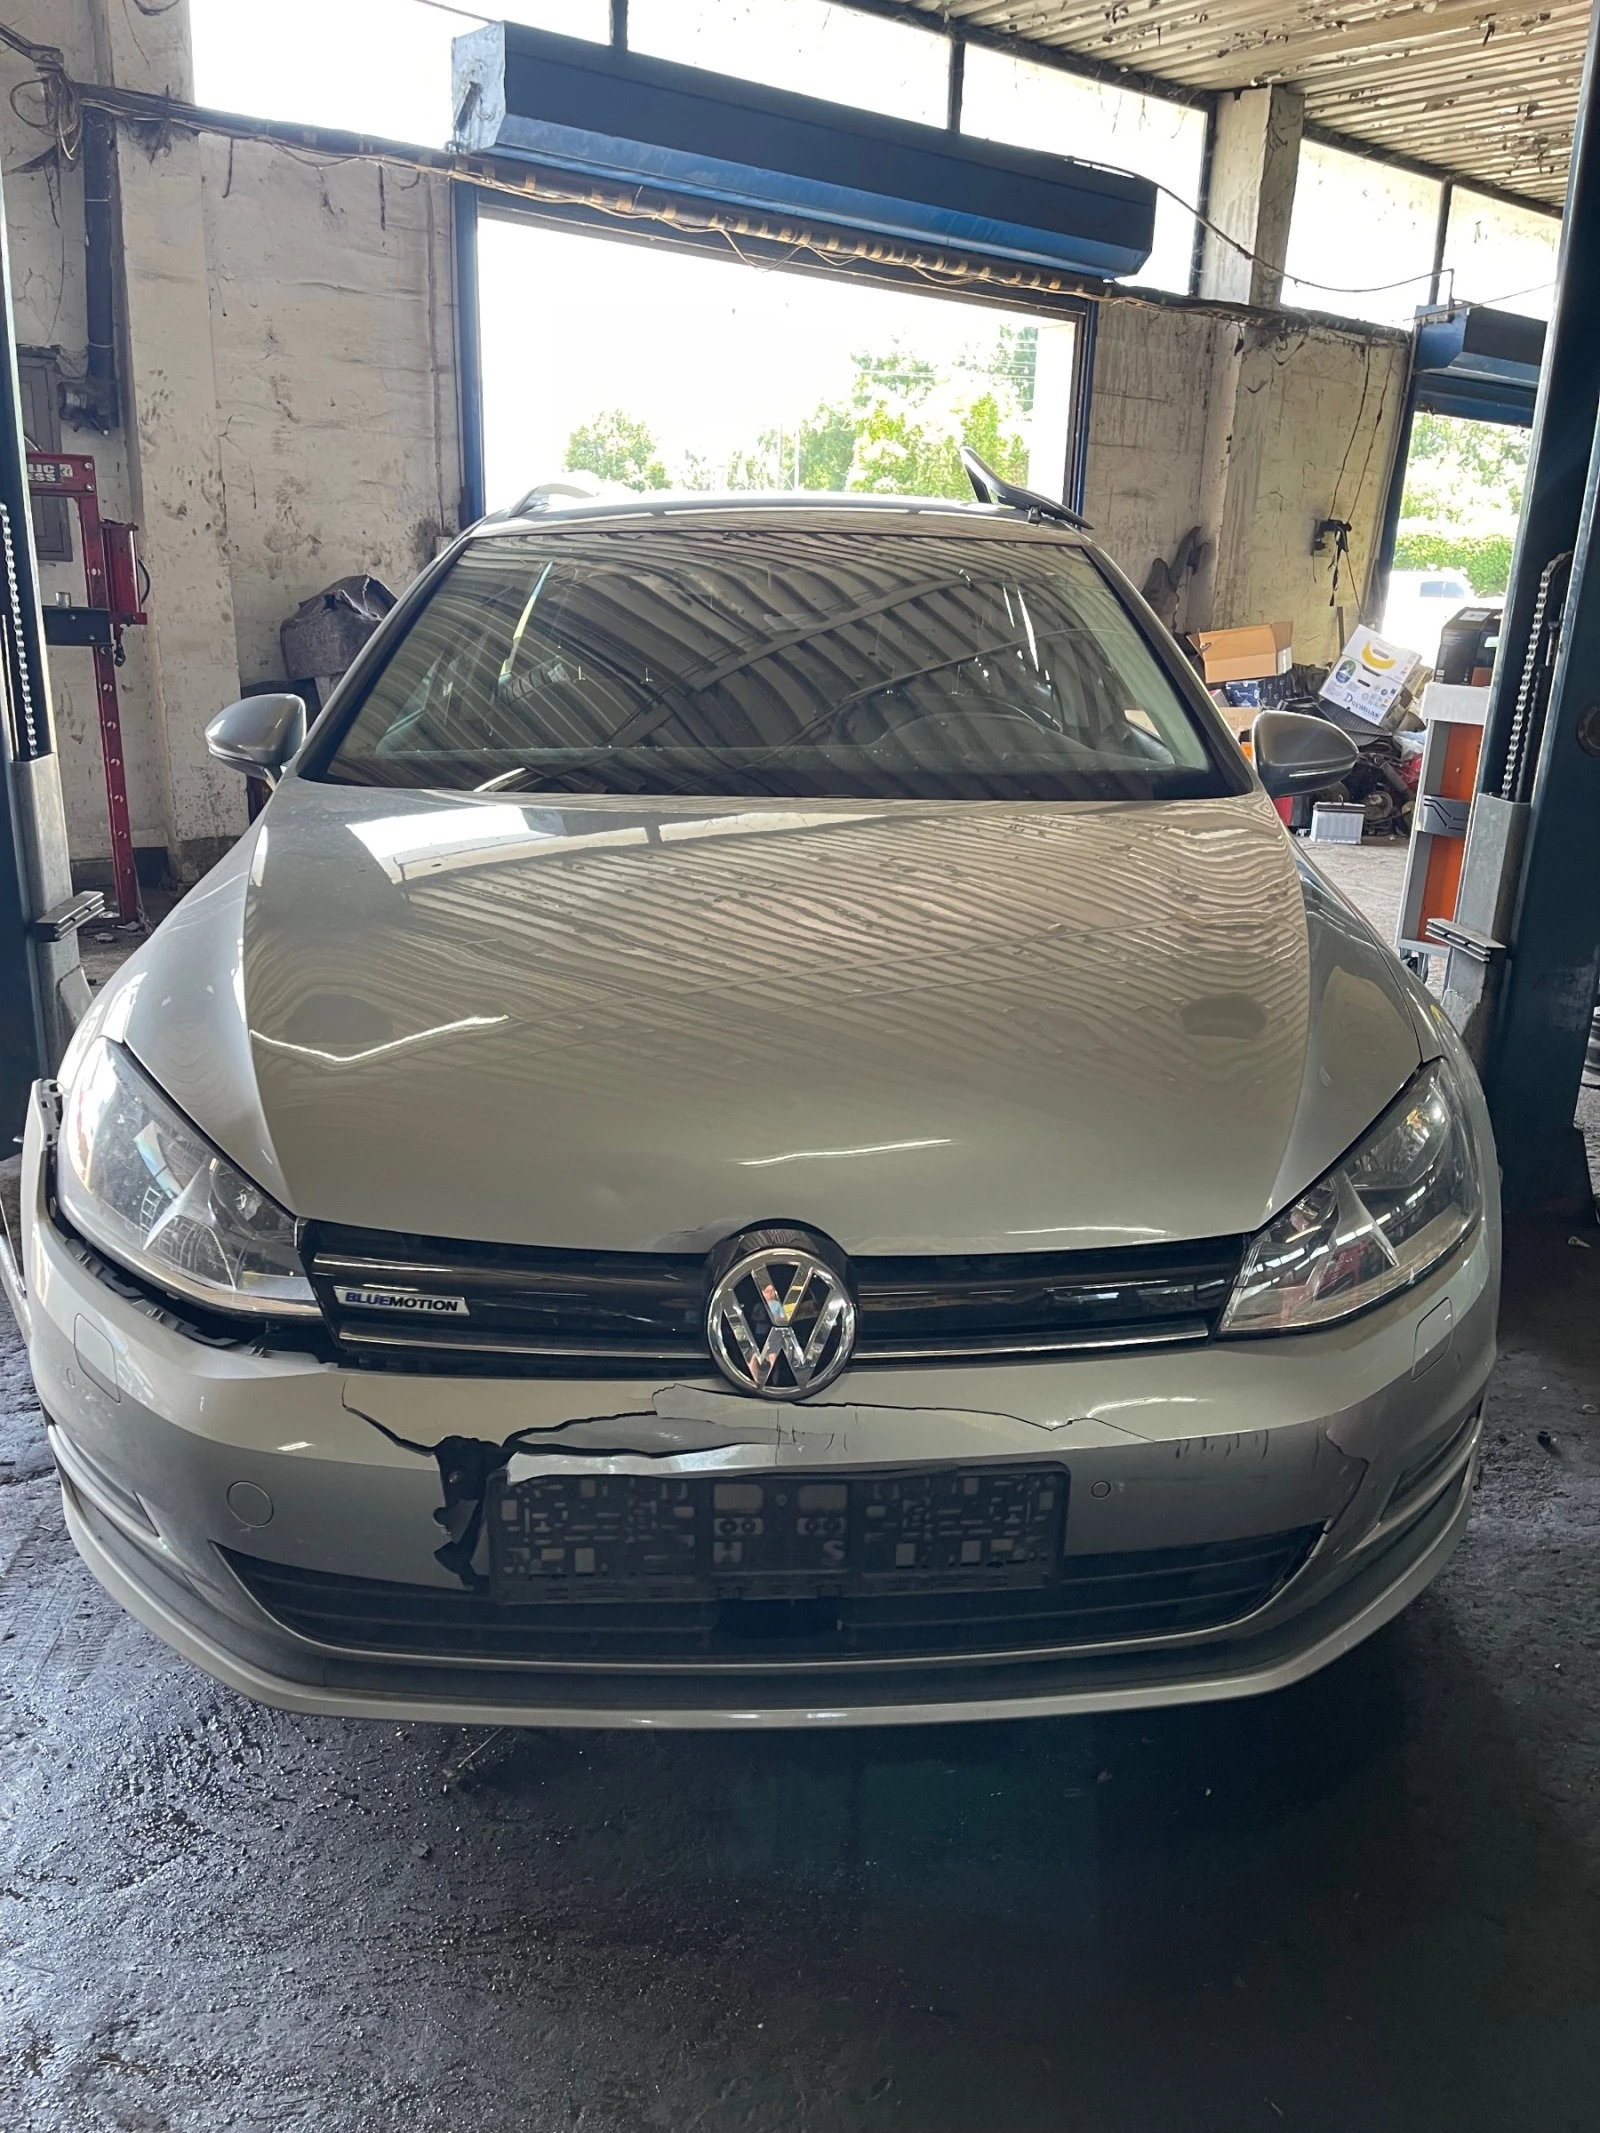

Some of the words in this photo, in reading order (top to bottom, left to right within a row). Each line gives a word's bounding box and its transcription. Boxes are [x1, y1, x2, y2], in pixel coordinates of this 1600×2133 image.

[28, 464, 55, 474] LIC
[28, 472, 56, 482] ESS
[345, 1292, 458, 1311] BLUEMOTION
[718, 1260, 846, 1389] VW
